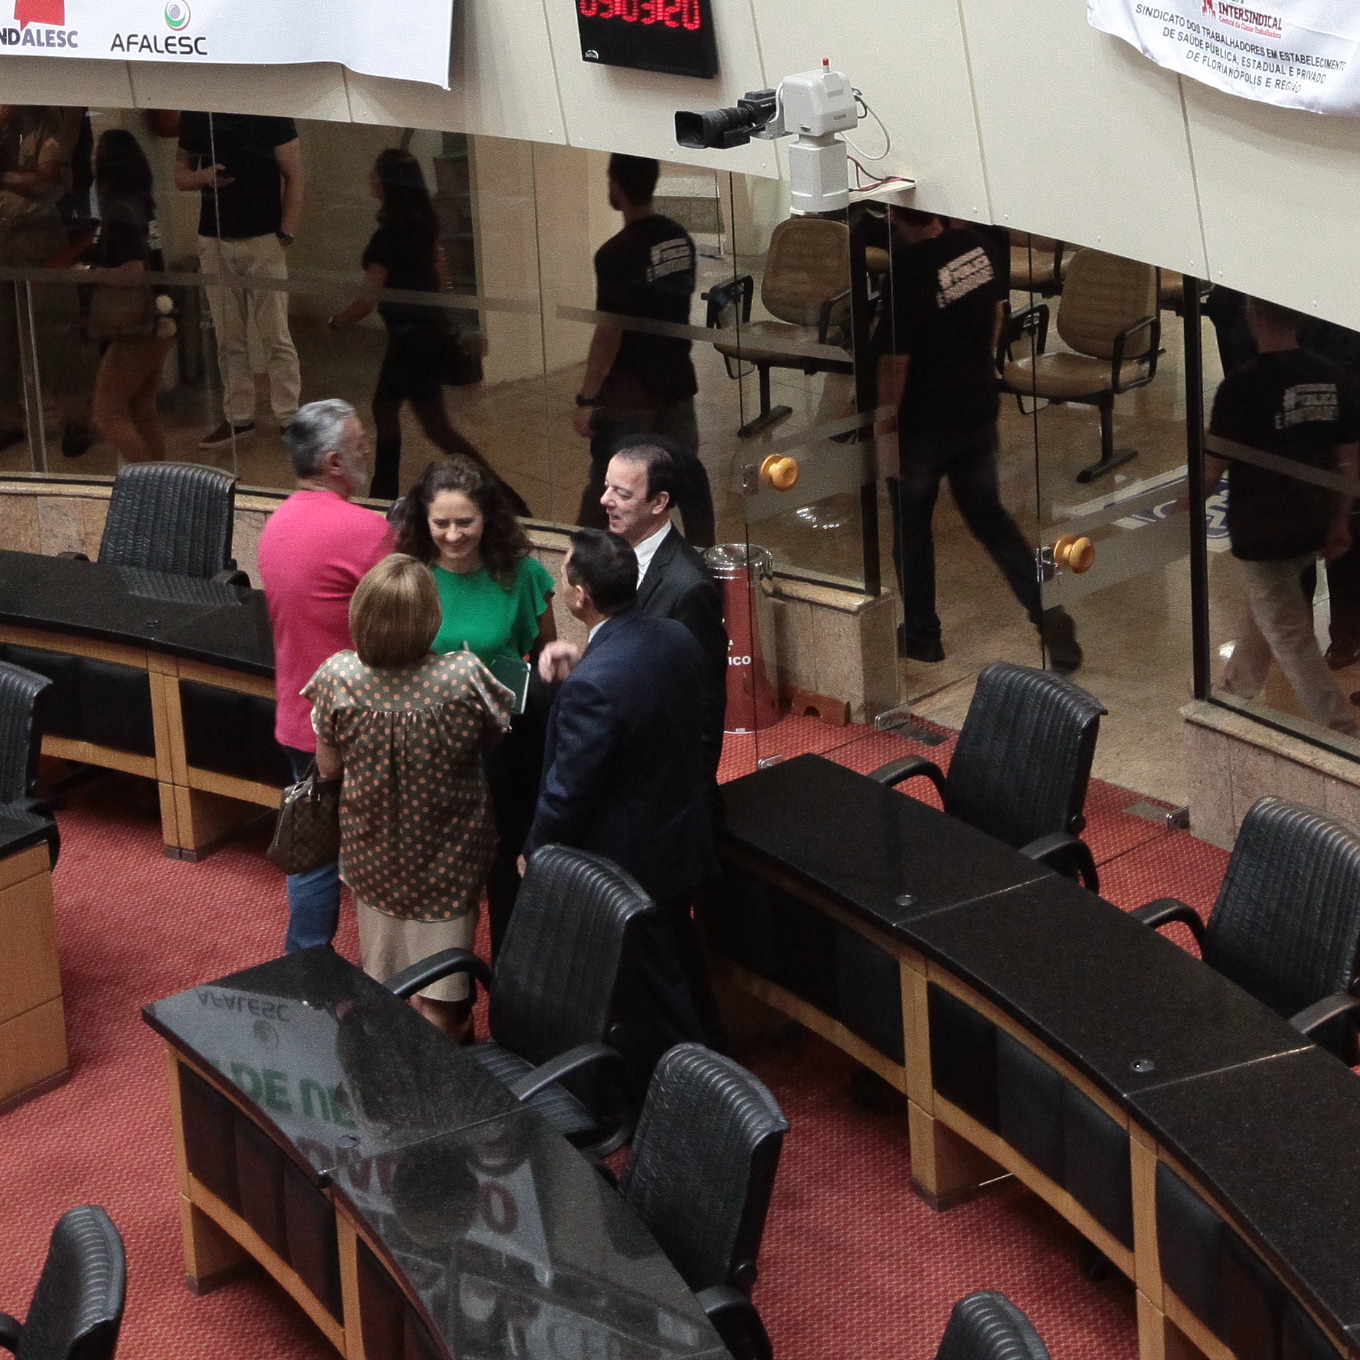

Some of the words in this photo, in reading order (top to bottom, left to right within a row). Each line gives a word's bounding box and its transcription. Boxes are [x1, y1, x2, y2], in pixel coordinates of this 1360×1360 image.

[1135, 3, 1185, 27] SINDICATO
[1186, 19, 1201, 34] DOS
[1202, 26, 1266, 56] TRABALHADORES
[1218, 1, 1283, 31] INTERSINDICAL
[110, 33, 208, 56] AFALESC
[1162, 26, 1175, 39] DE
[1176, 29, 1204, 50] SAÚDE
[1241, 57, 1287, 76] ESTADUAL
[1296, 68, 1327, 84] PRIVADO
[1186, 49, 1200, 63] DE
[1202, 54, 1262, 87] FLORIANÓPOLIS
